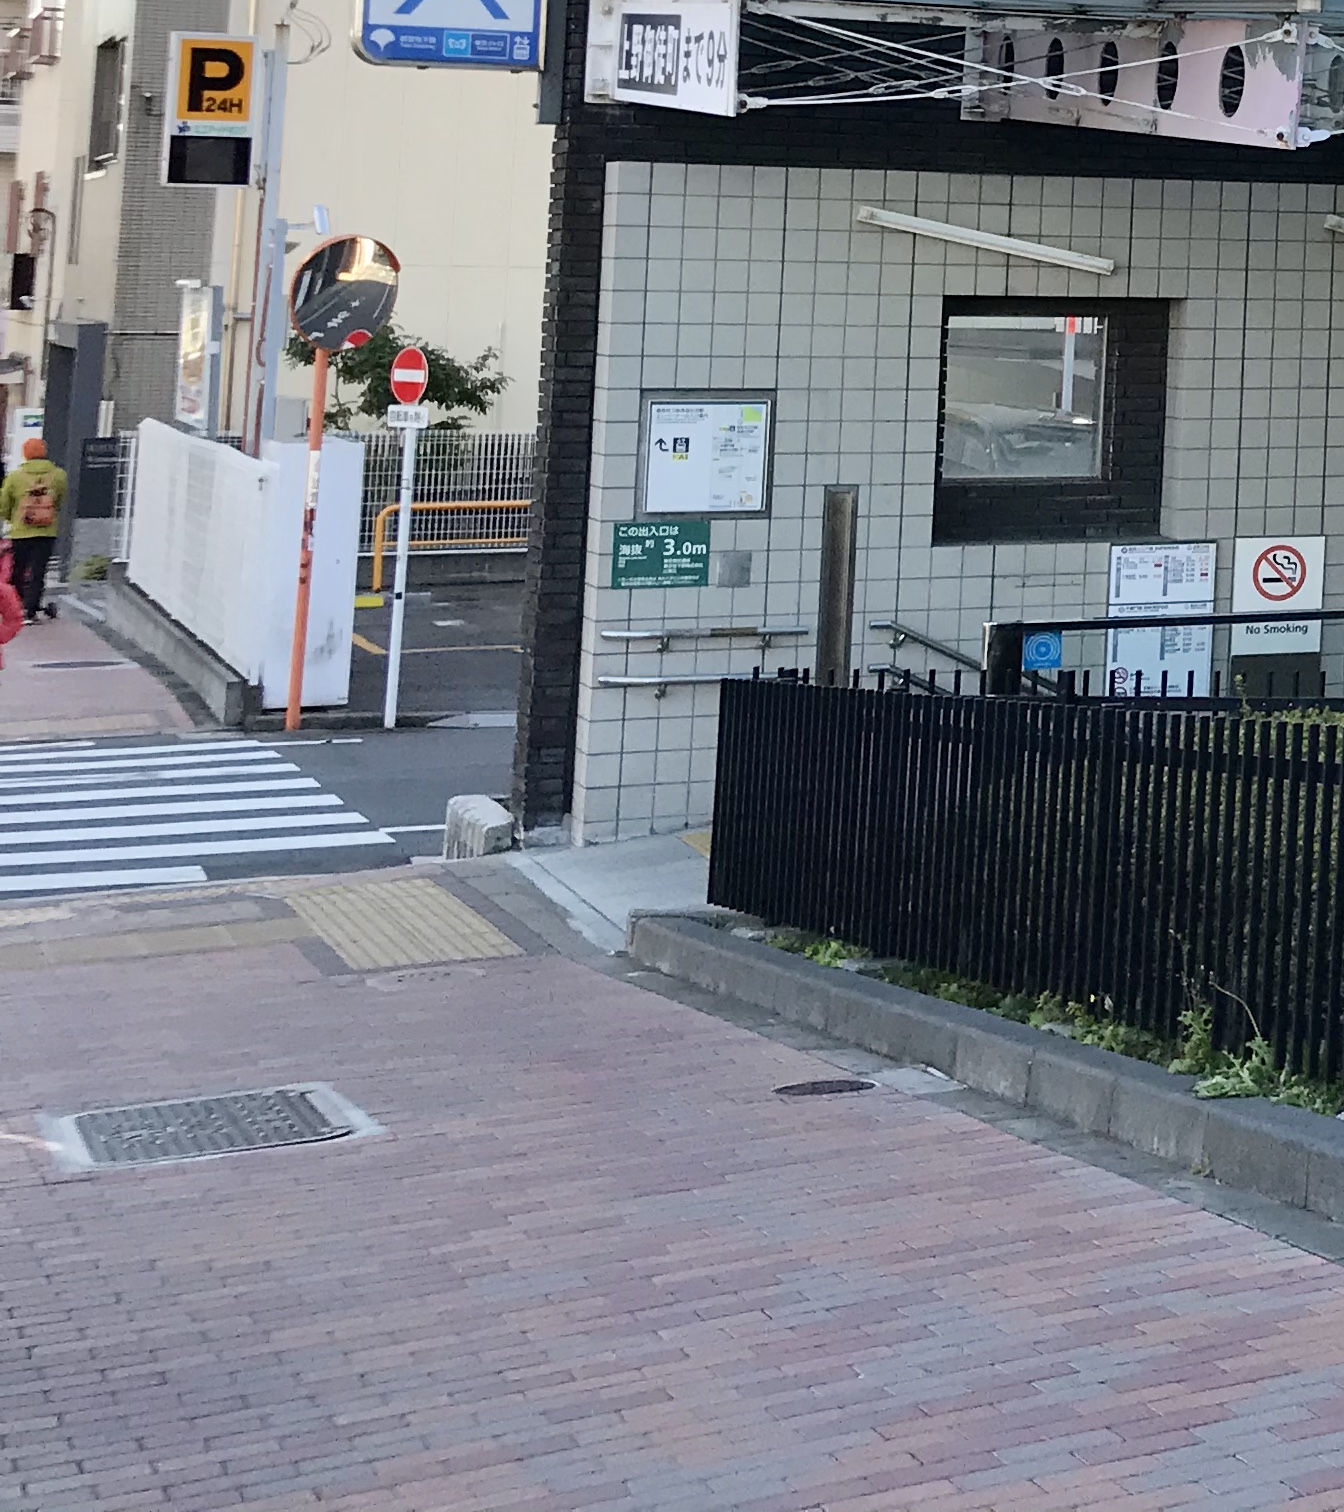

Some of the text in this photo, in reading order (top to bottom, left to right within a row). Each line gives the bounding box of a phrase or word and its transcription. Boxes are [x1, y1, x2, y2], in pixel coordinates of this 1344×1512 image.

[187, 47, 245, 113] P
[204, 96, 243, 115] 24H
[619, 525, 679, 537] この出入口は
[619, 544, 642, 556] 海抜
[662, 538, 707, 556] 3.0m
[1245, 623, 1308, 635] No Smoking
